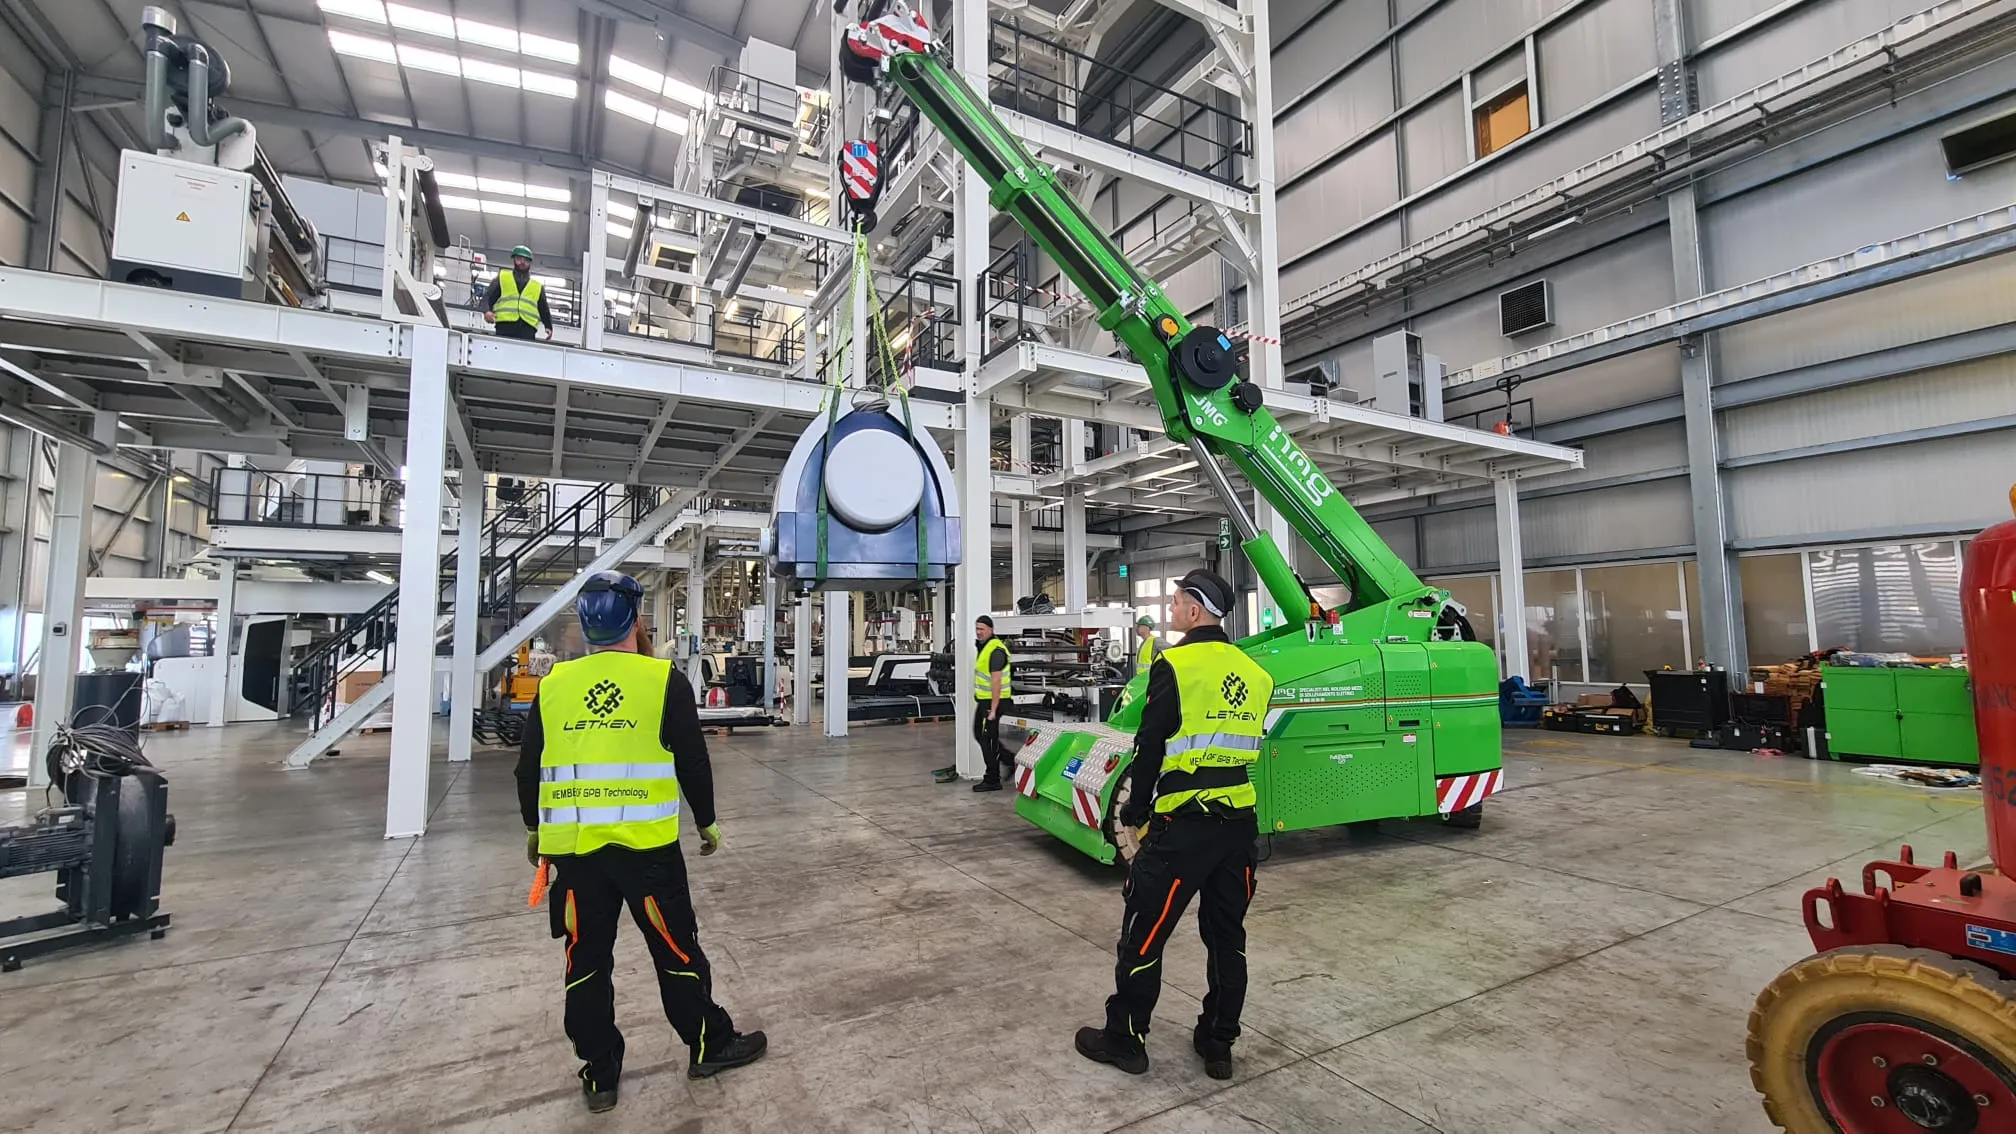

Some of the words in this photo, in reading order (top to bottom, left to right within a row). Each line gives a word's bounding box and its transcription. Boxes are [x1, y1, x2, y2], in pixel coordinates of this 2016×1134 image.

[1205, 710, 1258, 721] LETKEN
[562, 719, 638, 731] LETKEN
[583, 788, 601, 798] GPB
[603, 787, 649, 800] Technology
